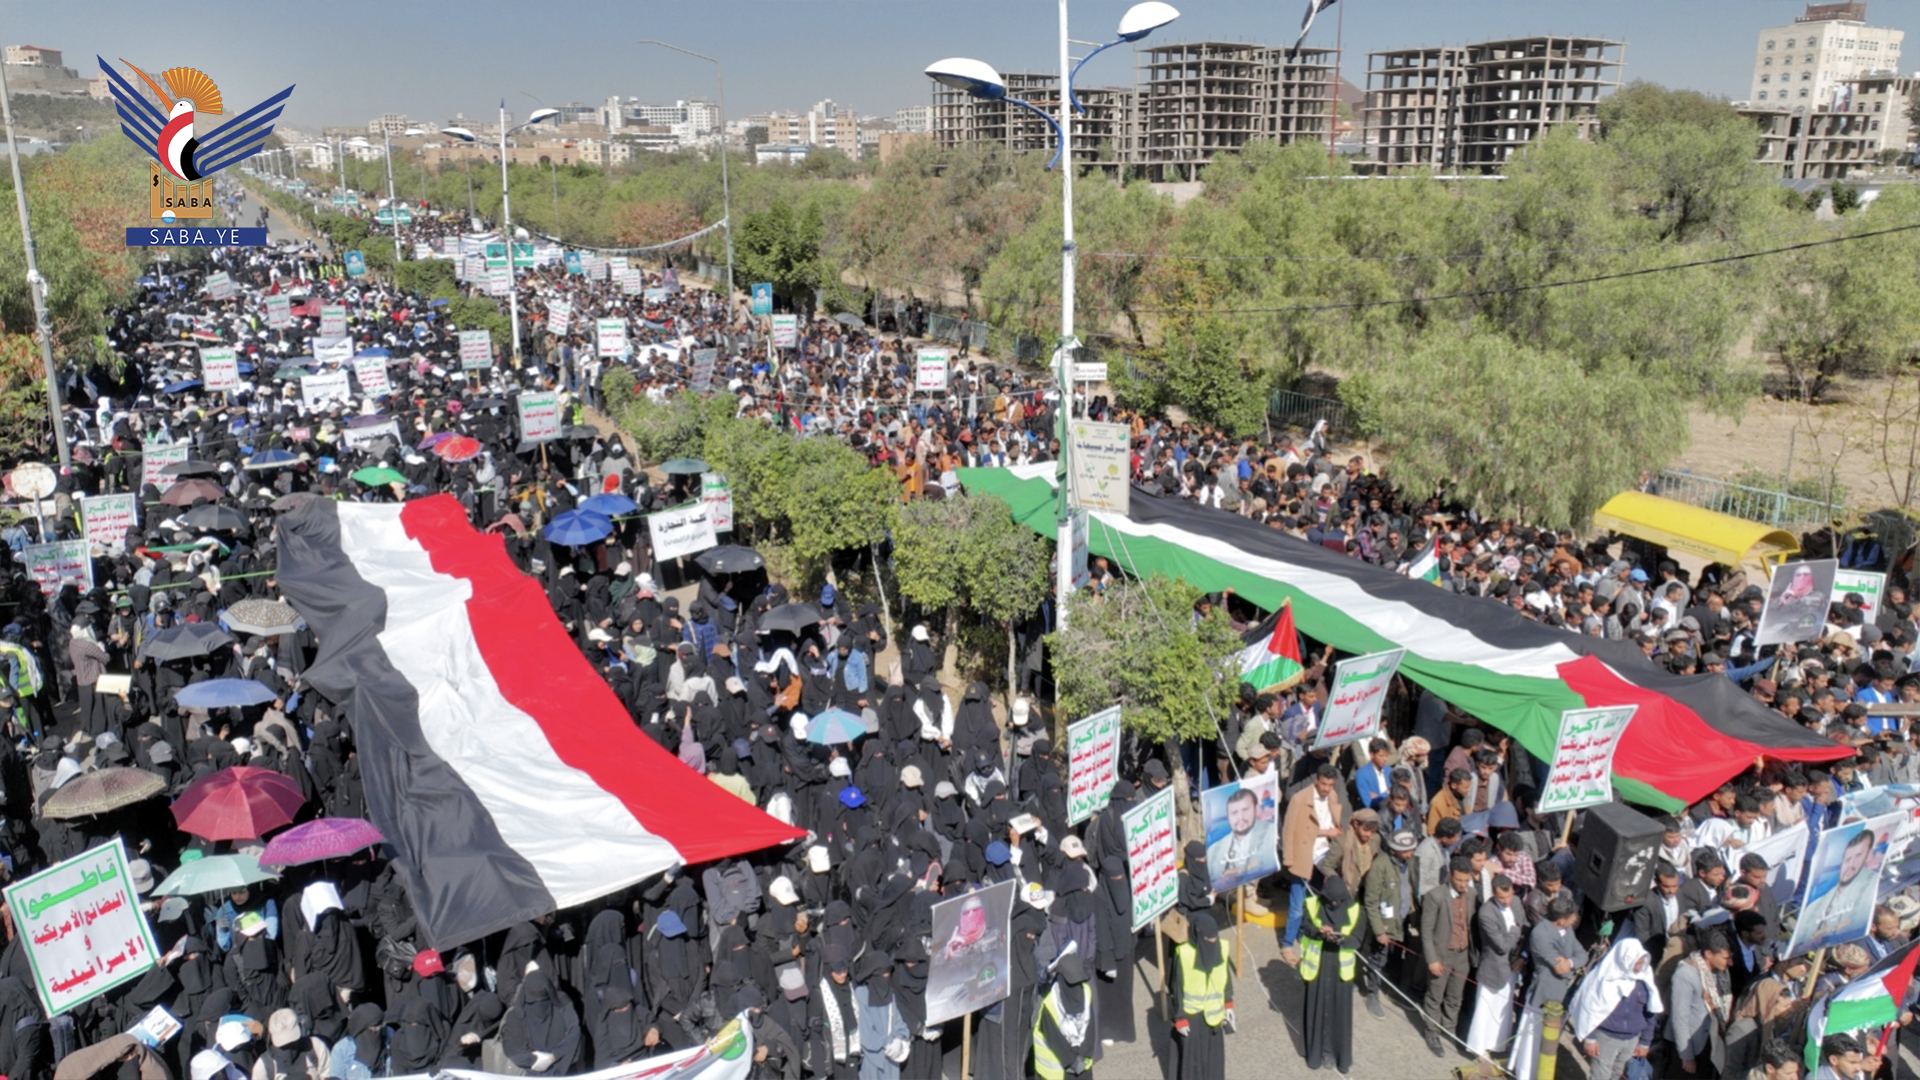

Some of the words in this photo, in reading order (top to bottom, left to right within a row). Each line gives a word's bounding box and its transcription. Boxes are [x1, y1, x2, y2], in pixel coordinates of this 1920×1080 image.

[19, 857, 118, 921] قاطعوا
[84, 890, 127, 927] البضائع
[32, 909, 84, 947] الأمريكية
[84, 934, 92, 951] و
[49, 935, 145, 993] الإسرائيلية
